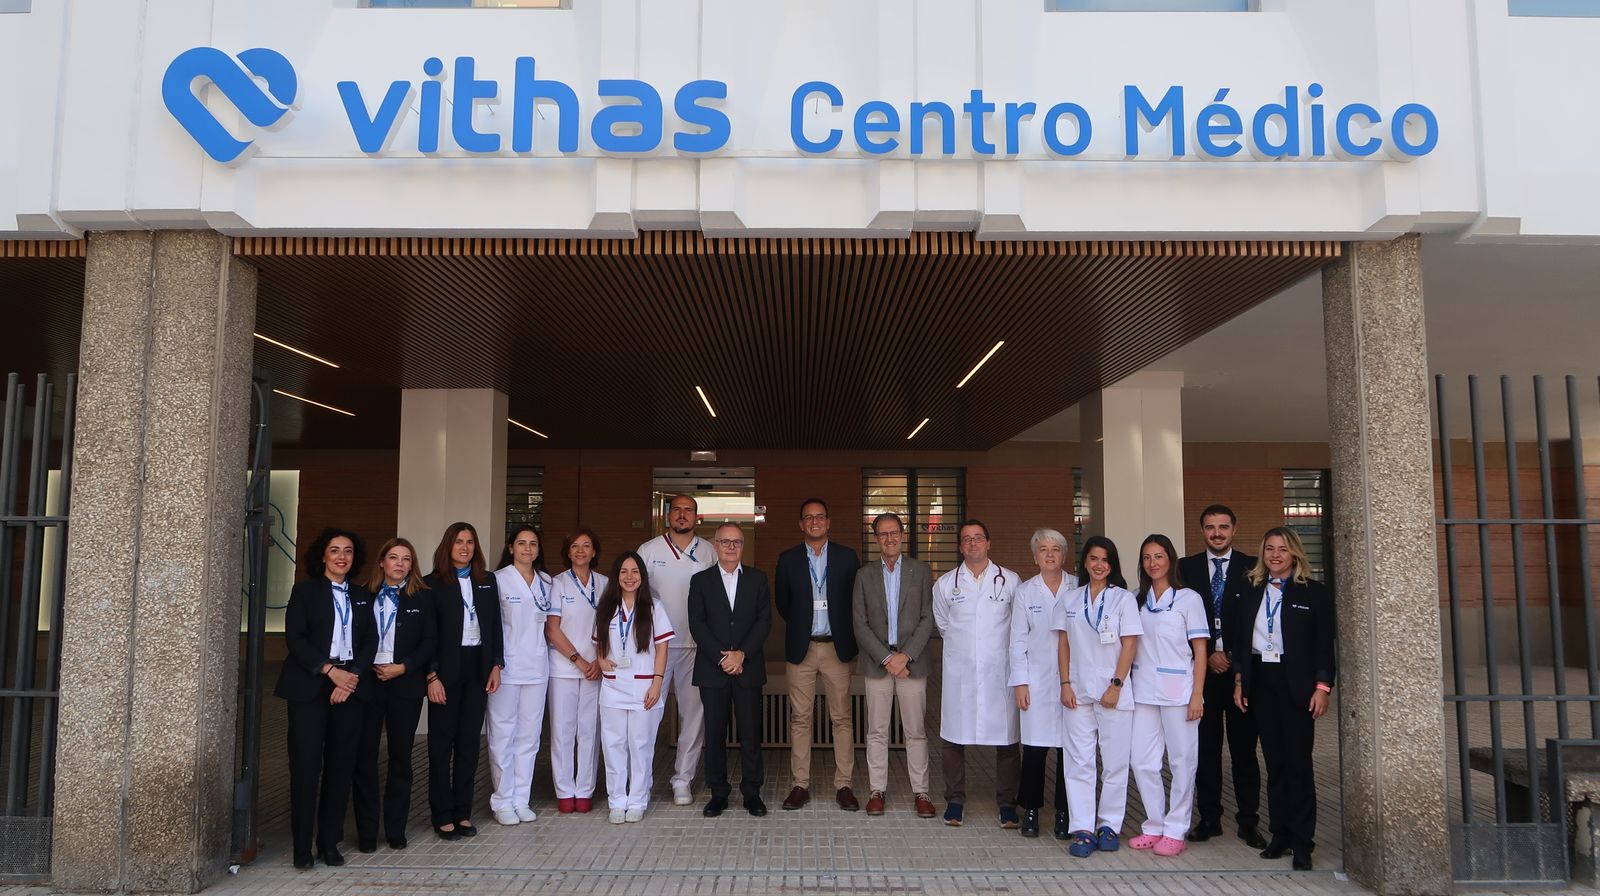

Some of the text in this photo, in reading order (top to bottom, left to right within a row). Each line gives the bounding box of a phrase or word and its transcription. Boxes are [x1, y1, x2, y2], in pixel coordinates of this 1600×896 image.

[337, 58, 1438, 157] vithas Centro Médico
